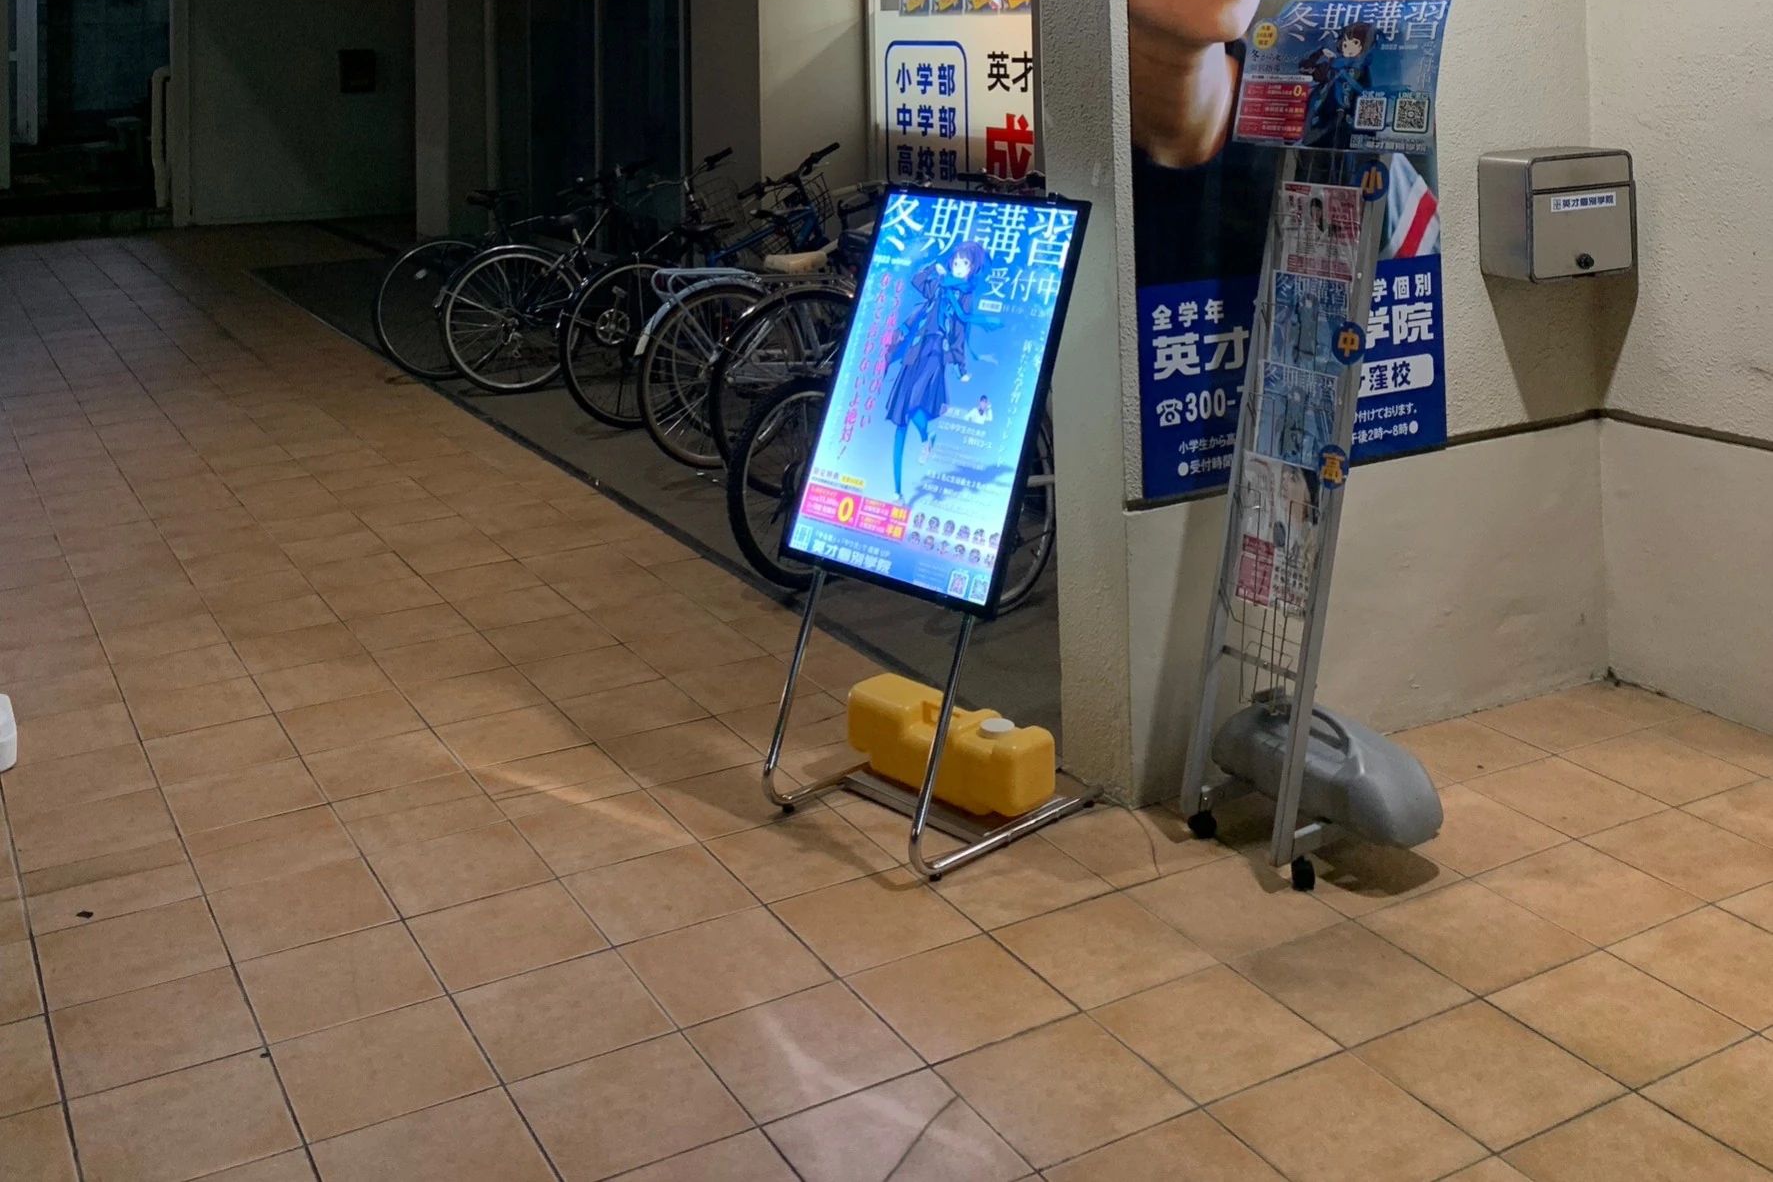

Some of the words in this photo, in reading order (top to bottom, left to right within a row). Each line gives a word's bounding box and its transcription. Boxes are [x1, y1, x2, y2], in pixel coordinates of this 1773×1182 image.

[1280, 0, 1449, 43] 冬期講習
[896, 62, 956, 97] 小学部
[987, 51, 1033, 93] 英才
[896, 103, 957, 139] 中学部
[896, 144, 958, 181] 高校部
[986, 113, 1034, 180] 成
[1362, 170, 1383, 192] 小
[880, 194, 1078, 270] 冬期講習
[984, 267, 1061, 306] 受付中
[1152, 298, 1224, 331] 全学年
[1152, 326, 1250, 381] 英才
[1338, 329, 1360, 357] 中
[1360, 361, 1411, 391] 窪校
[1322, 452, 1344, 481] 高
